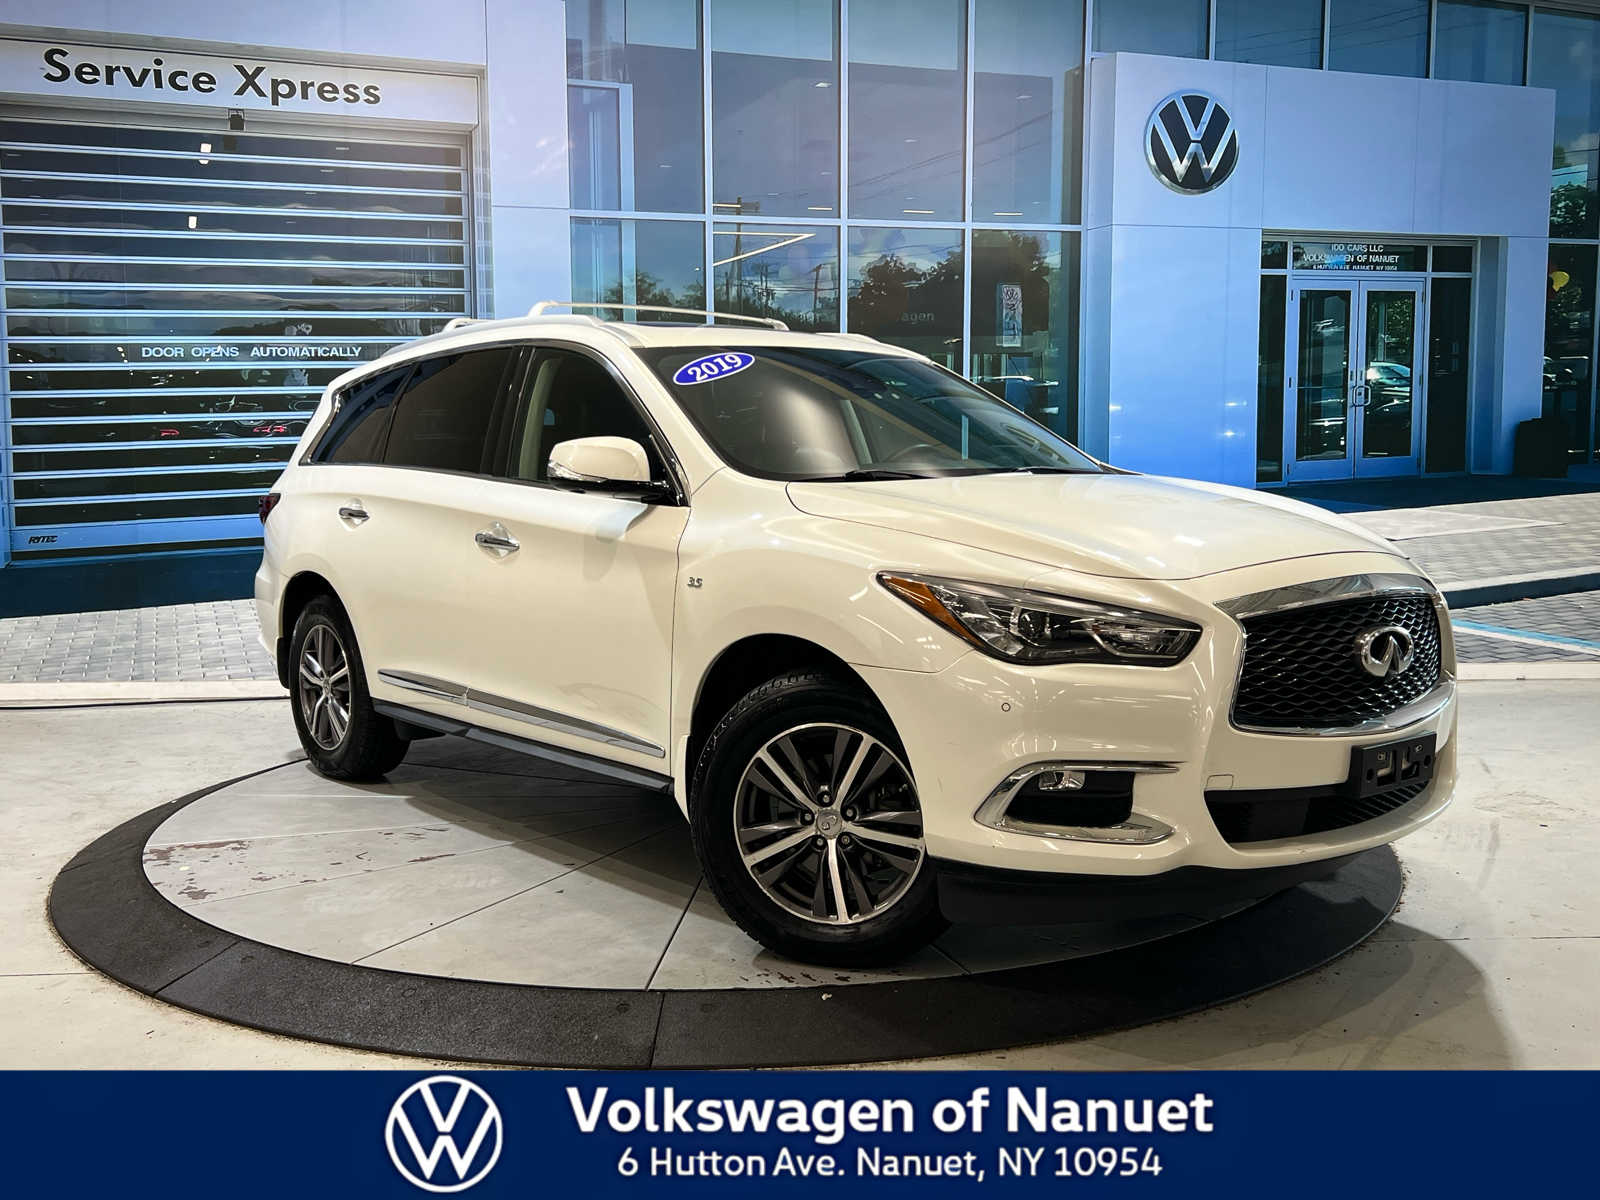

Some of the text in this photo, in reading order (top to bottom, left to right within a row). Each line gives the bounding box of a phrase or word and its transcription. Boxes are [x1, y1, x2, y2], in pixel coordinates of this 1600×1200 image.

[43, 48, 382, 106] Service Xpress
[1347, 244, 1368, 253] CARS
[1369, 245, 1384, 253] LLC
[1356, 254, 1368, 263] OF
[1369, 255, 1399, 264] NANUET
[142, 346, 362, 358] DOOR OPENS AUTOMATICALLY
[687, 354, 743, 382] 2019
